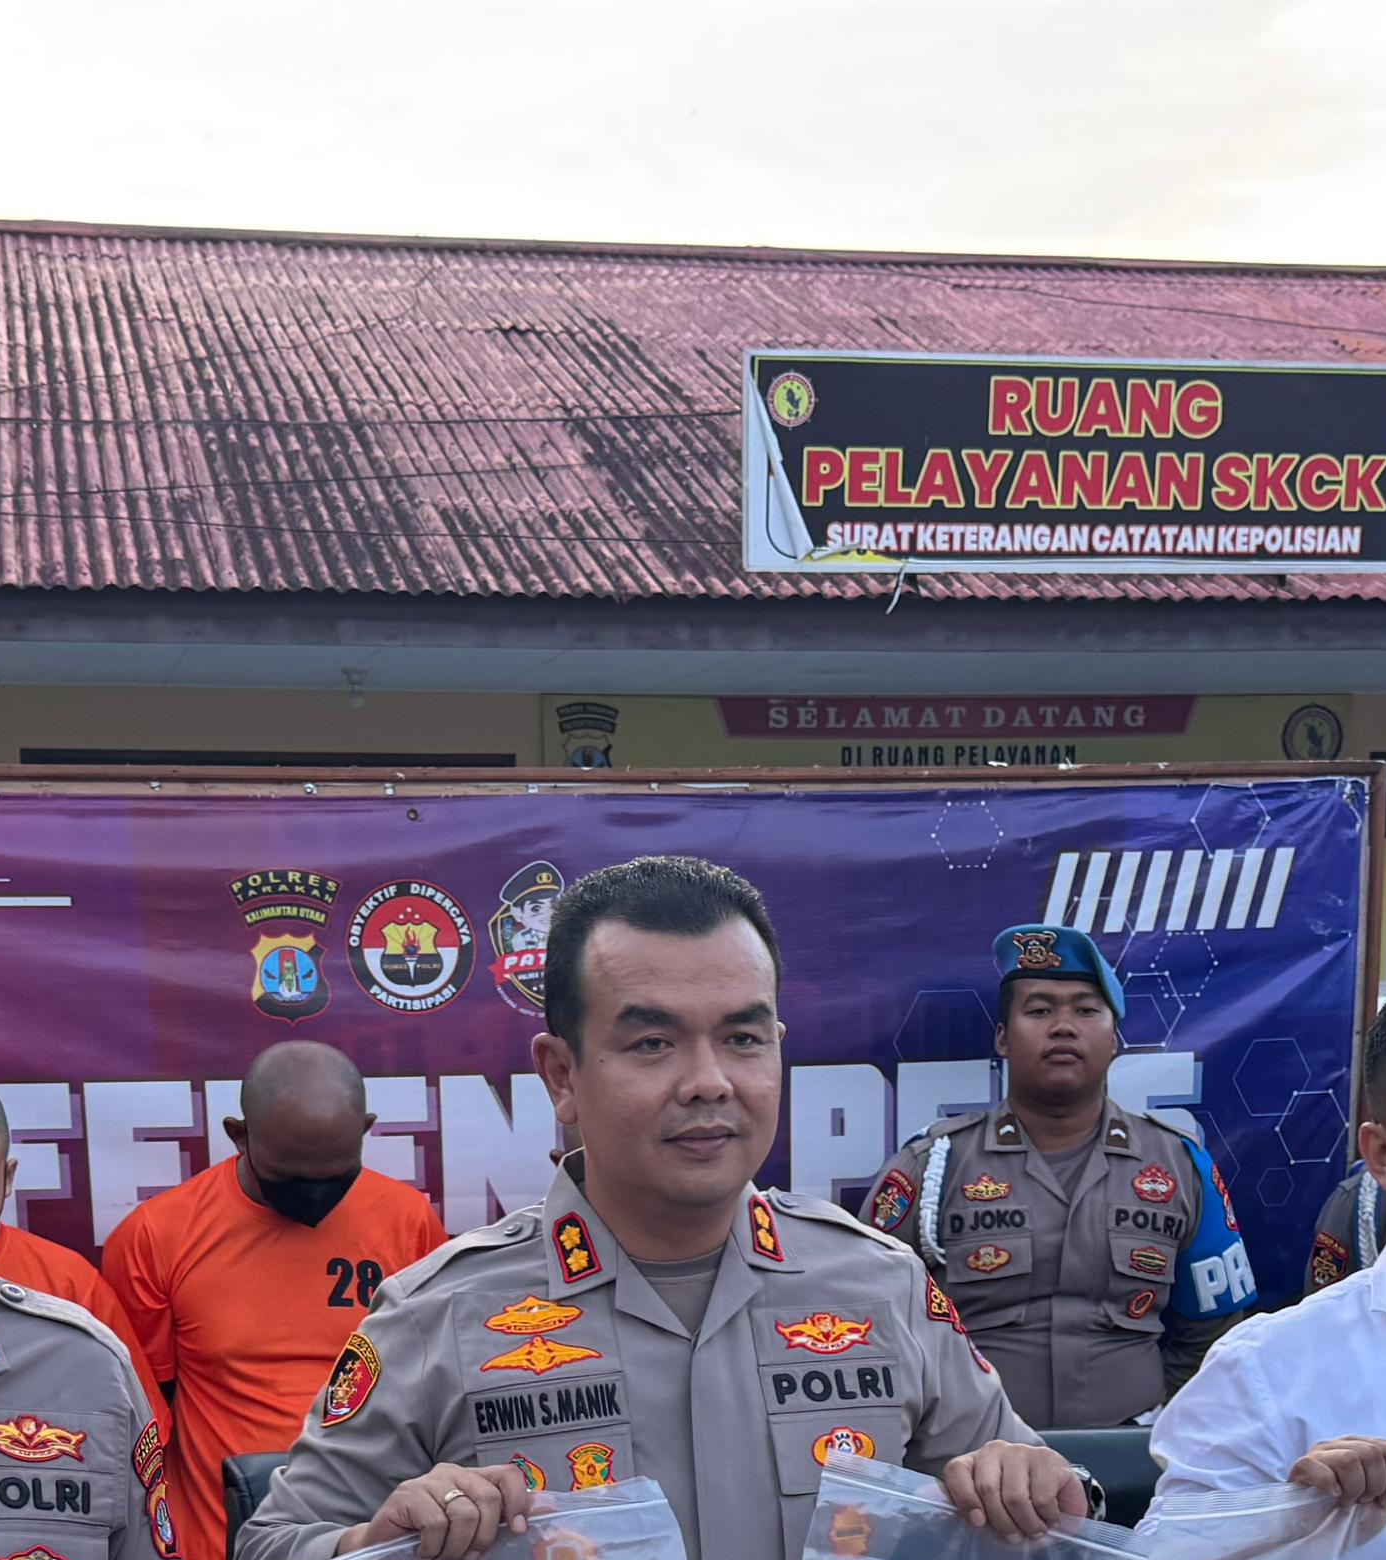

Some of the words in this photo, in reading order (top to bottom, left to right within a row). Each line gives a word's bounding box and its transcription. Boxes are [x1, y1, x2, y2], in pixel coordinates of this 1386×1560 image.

[989, 375, 1222, 438] RUANG
[802, 446, 1205, 511] PELAYANAN
[826, 521, 914, 552] SURAT
[916, 522, 1090, 553] KETERANGAN
[1092, 524, 1215, 554] CATATAN
[1217, 525, 1361, 555] KEPOLISIAN
[768, 704, 966, 730] SELAMAT
[982, 703, 1148, 728] DATANG
[840, 745, 864, 766] DI
[868, 745, 945, 766] RUANG
[953, 743, 1078, 766] PELAYANAN
[231, 871, 338, 893] POLRES
[236, 884, 333, 903] TARAKAN
[349, 885, 398, 947] OBYEKTIF
[410, 883, 472, 945] DIPERCAYA
[369, 984, 457, 1010] PARTISIPASI
[950, 1214, 963, 1234] D
[970, 1209, 1026, 1231] JOKO
[1115, 1208, 1183, 1240] POLRI
[326, 1258, 382, 1308] 28
[772, 1366, 894, 1405] POLRI
[475, 1395, 536, 1435] ERWIN
[540, 1383, 621, 1426] S.MANIK
